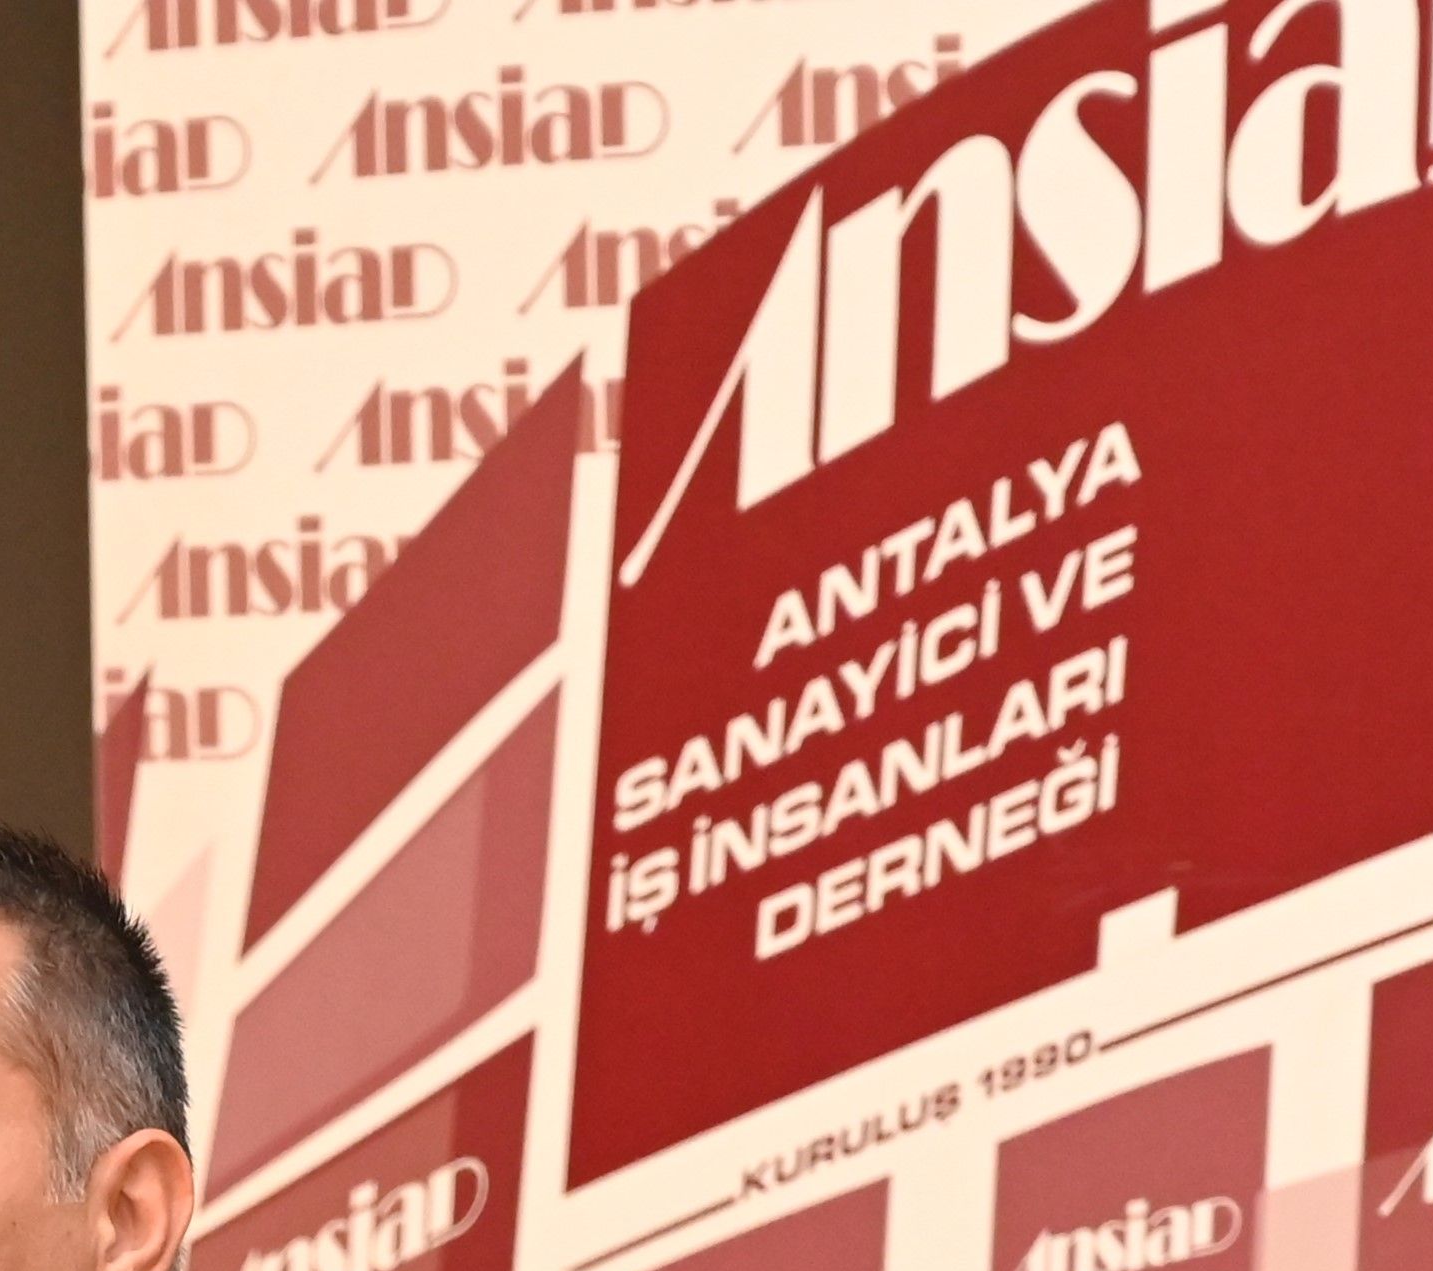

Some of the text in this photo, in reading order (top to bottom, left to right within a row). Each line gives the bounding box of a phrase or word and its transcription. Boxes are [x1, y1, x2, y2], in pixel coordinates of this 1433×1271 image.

[756, 420, 1141, 670] ANTALYA
[607, 636, 1129, 935] İŞ İNSANLARI
[613, 526, 1138, 832] SANAYİCİ VE
[756, 734, 1121, 961] DERNEĞİ
[977, 1029, 1092, 1099] 1990
